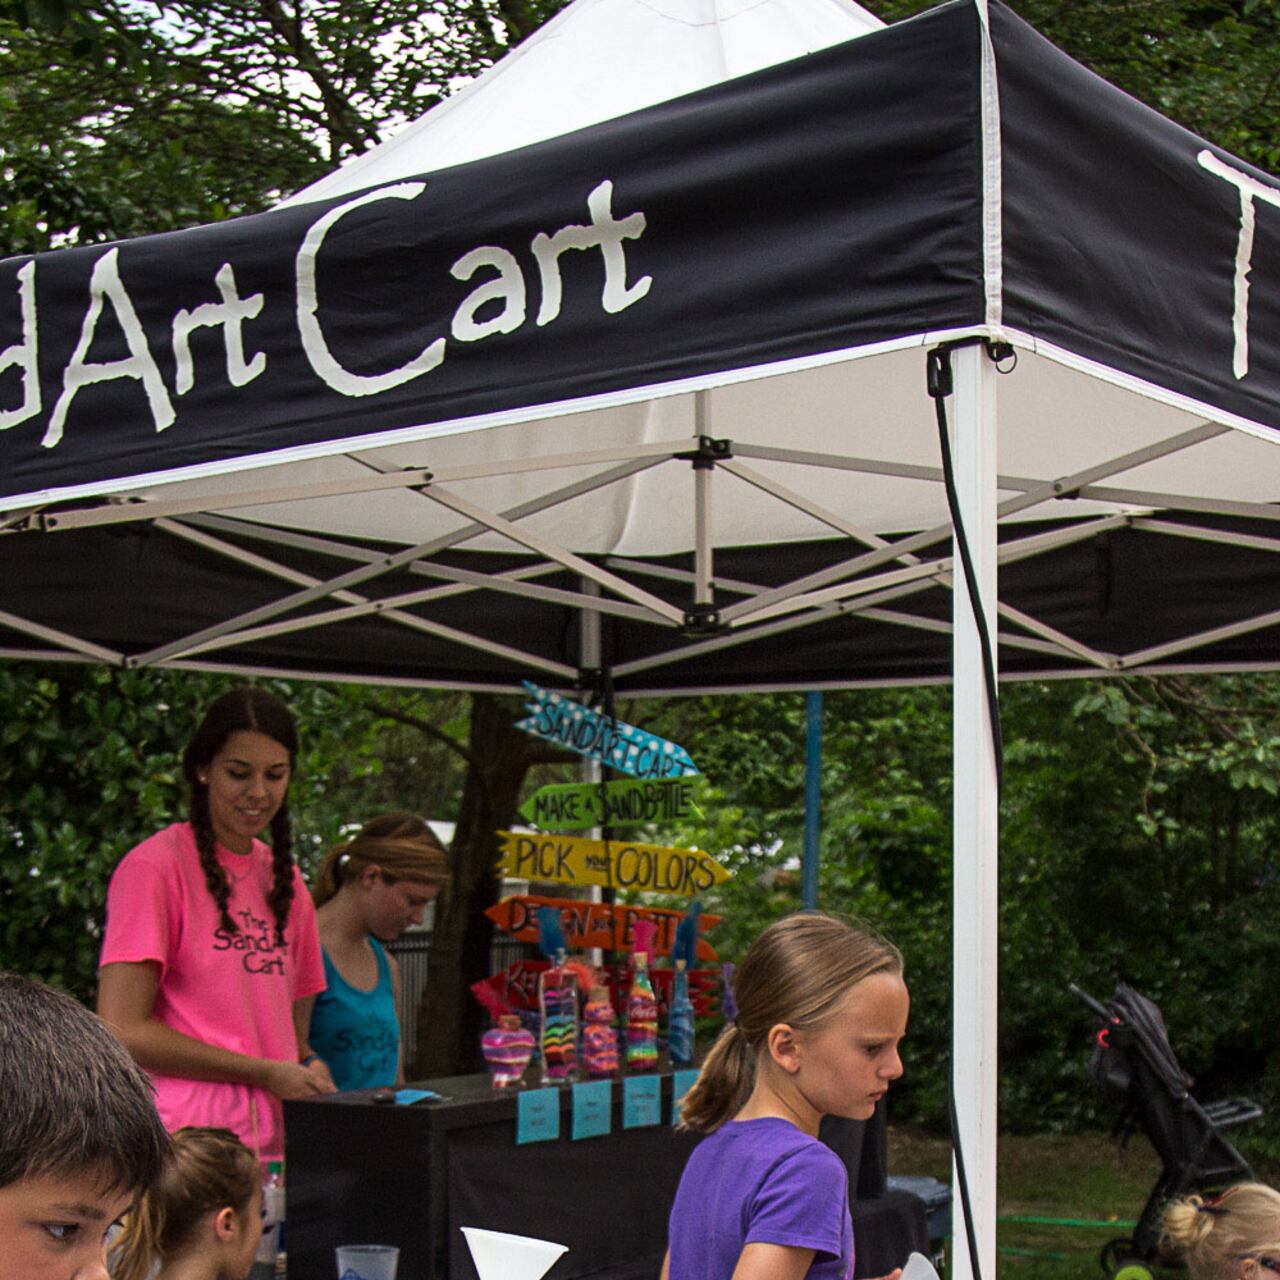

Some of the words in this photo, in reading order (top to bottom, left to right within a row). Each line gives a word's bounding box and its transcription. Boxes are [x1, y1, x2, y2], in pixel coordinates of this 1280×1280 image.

[41, 247, 267, 448] Art
[295, 180, 653, 397] Cart
[534, 792, 581, 823] MAKE
[516, 838, 576, 880] PICK
[617, 847, 716, 896] COLORS
[213, 927, 273, 953] Sand
